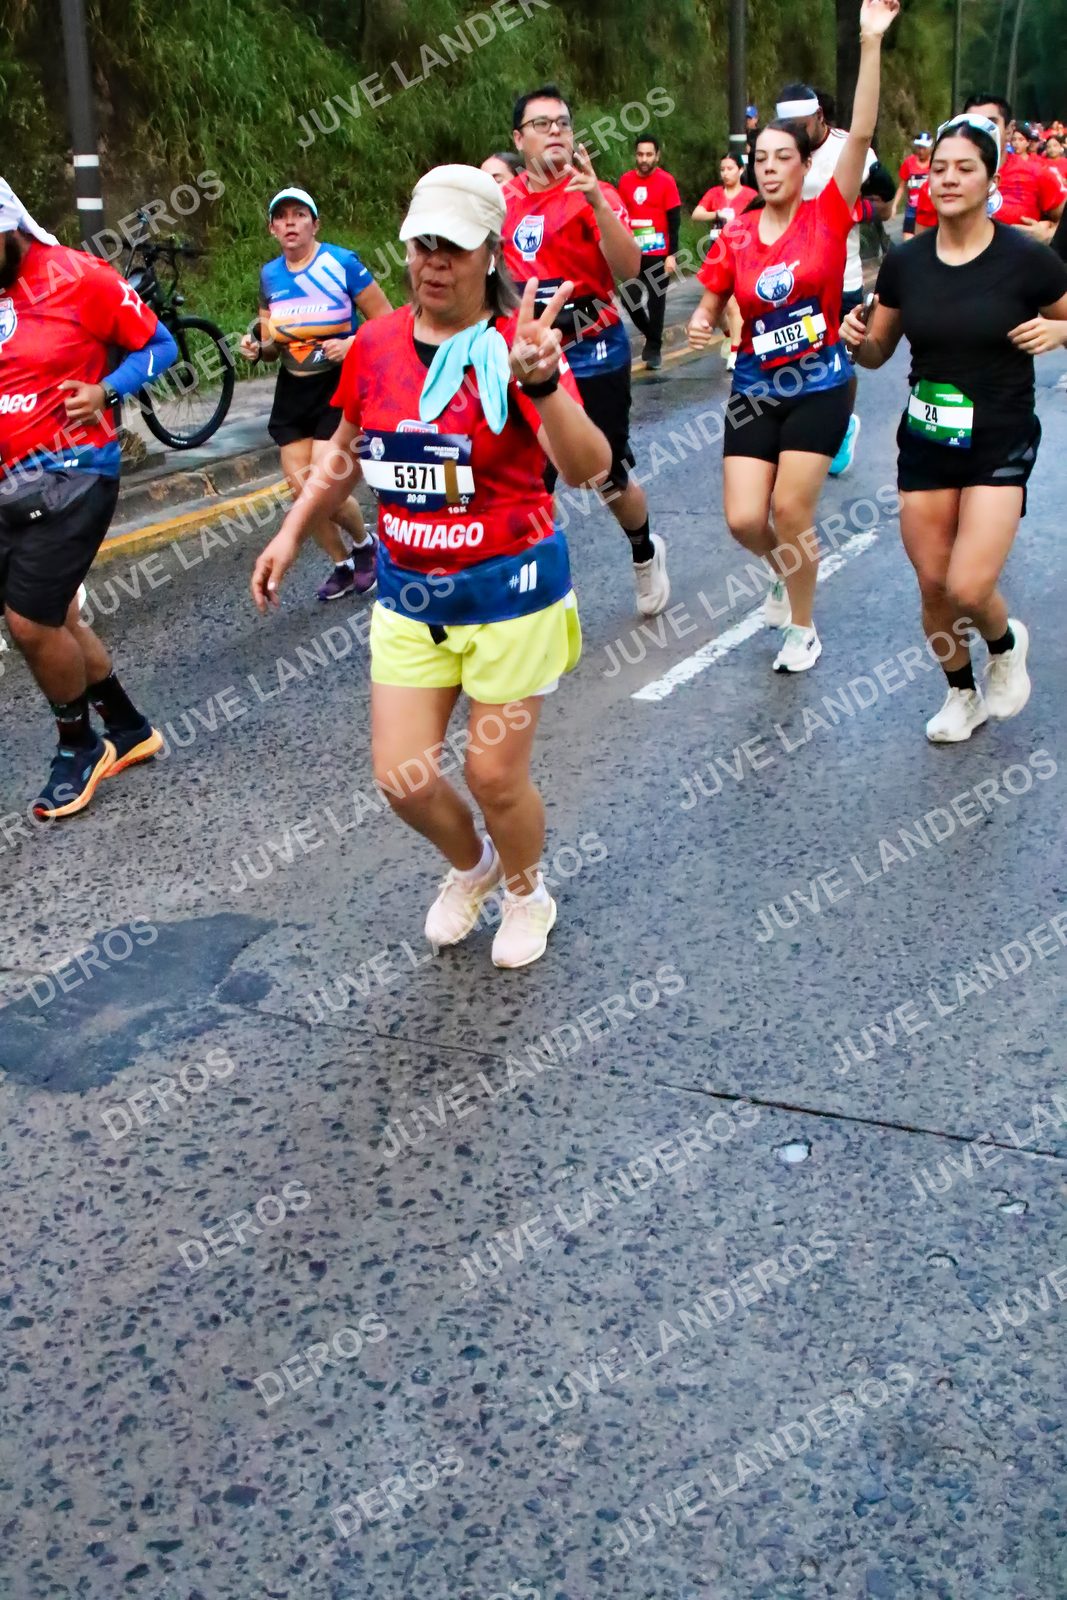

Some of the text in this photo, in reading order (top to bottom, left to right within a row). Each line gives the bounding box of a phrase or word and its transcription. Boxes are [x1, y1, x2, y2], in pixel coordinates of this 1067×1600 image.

[774, 324, 805, 346] 4162
[925, 404, 938, 423] 24
[394, 464, 437, 490] 5371
[383, 513, 484, 550] SANTIAGO
